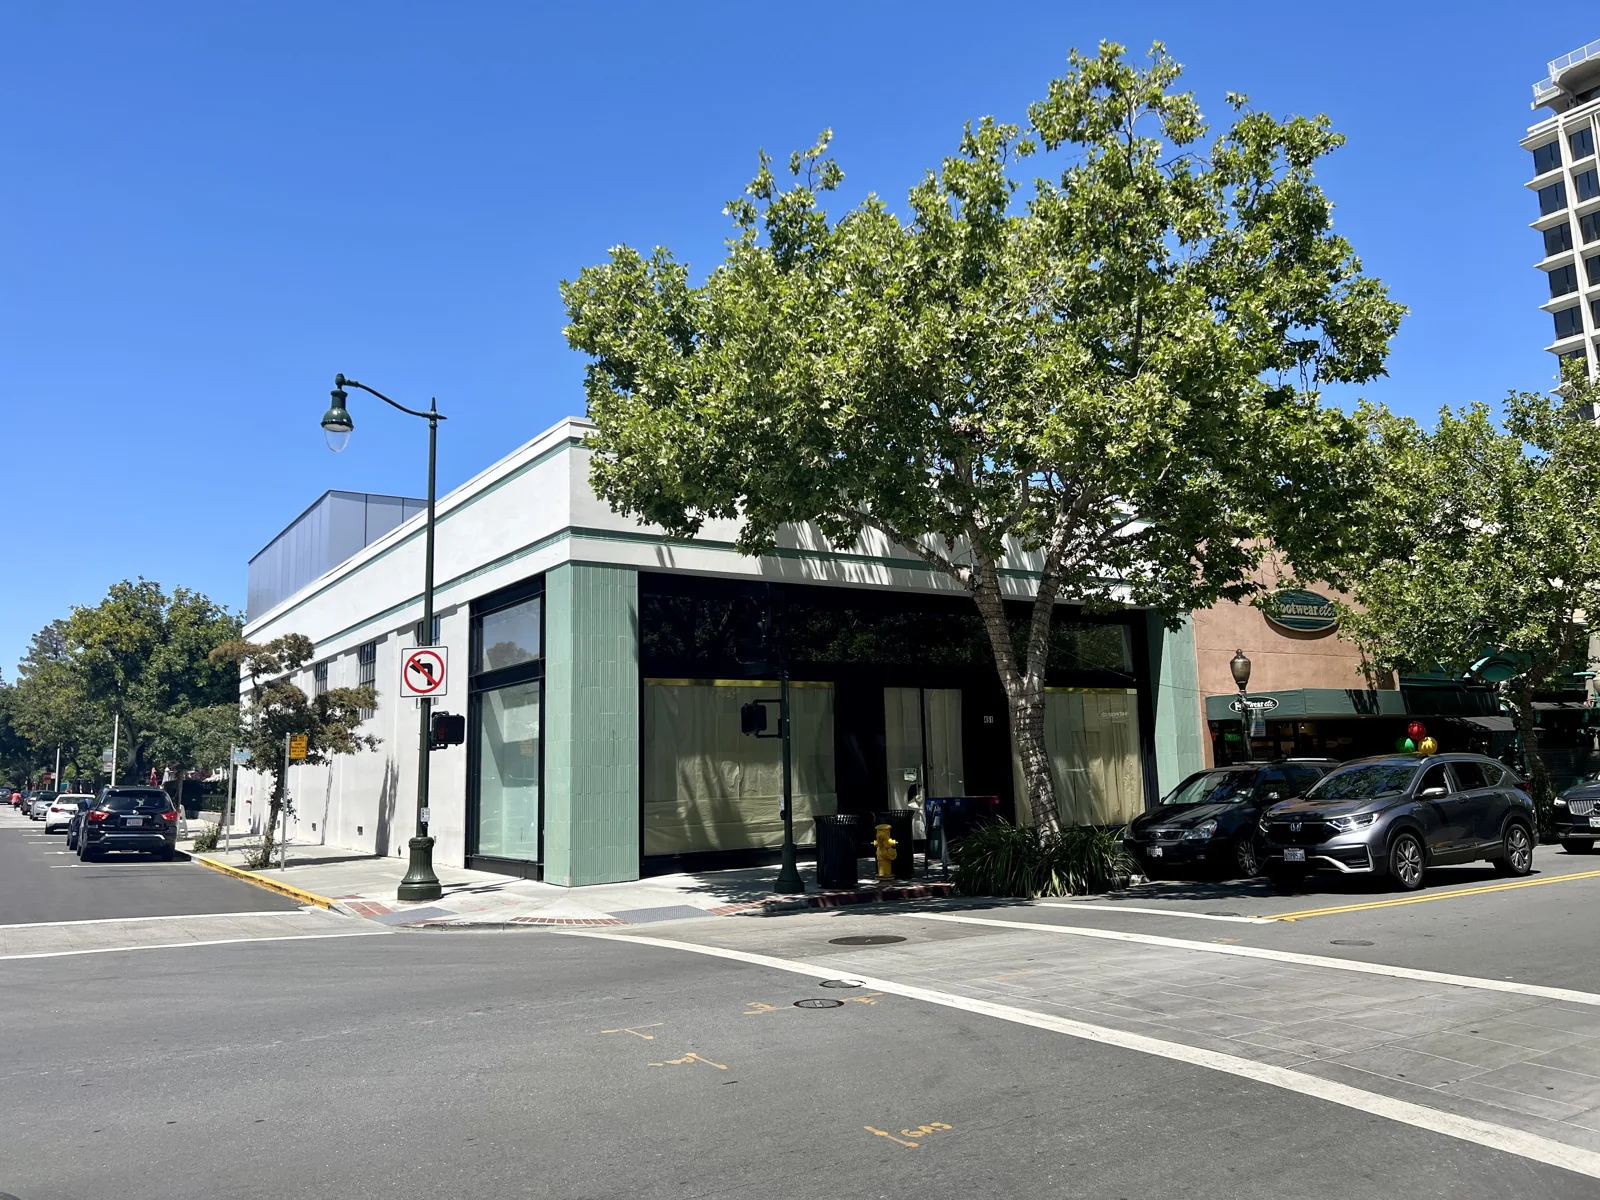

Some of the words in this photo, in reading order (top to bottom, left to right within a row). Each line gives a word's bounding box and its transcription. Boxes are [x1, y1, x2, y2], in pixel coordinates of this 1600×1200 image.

[1279, 602, 1318, 616] ootwear
[1319, 604, 1335, 617] etc.
[1234, 701, 1264, 711] Fwear
